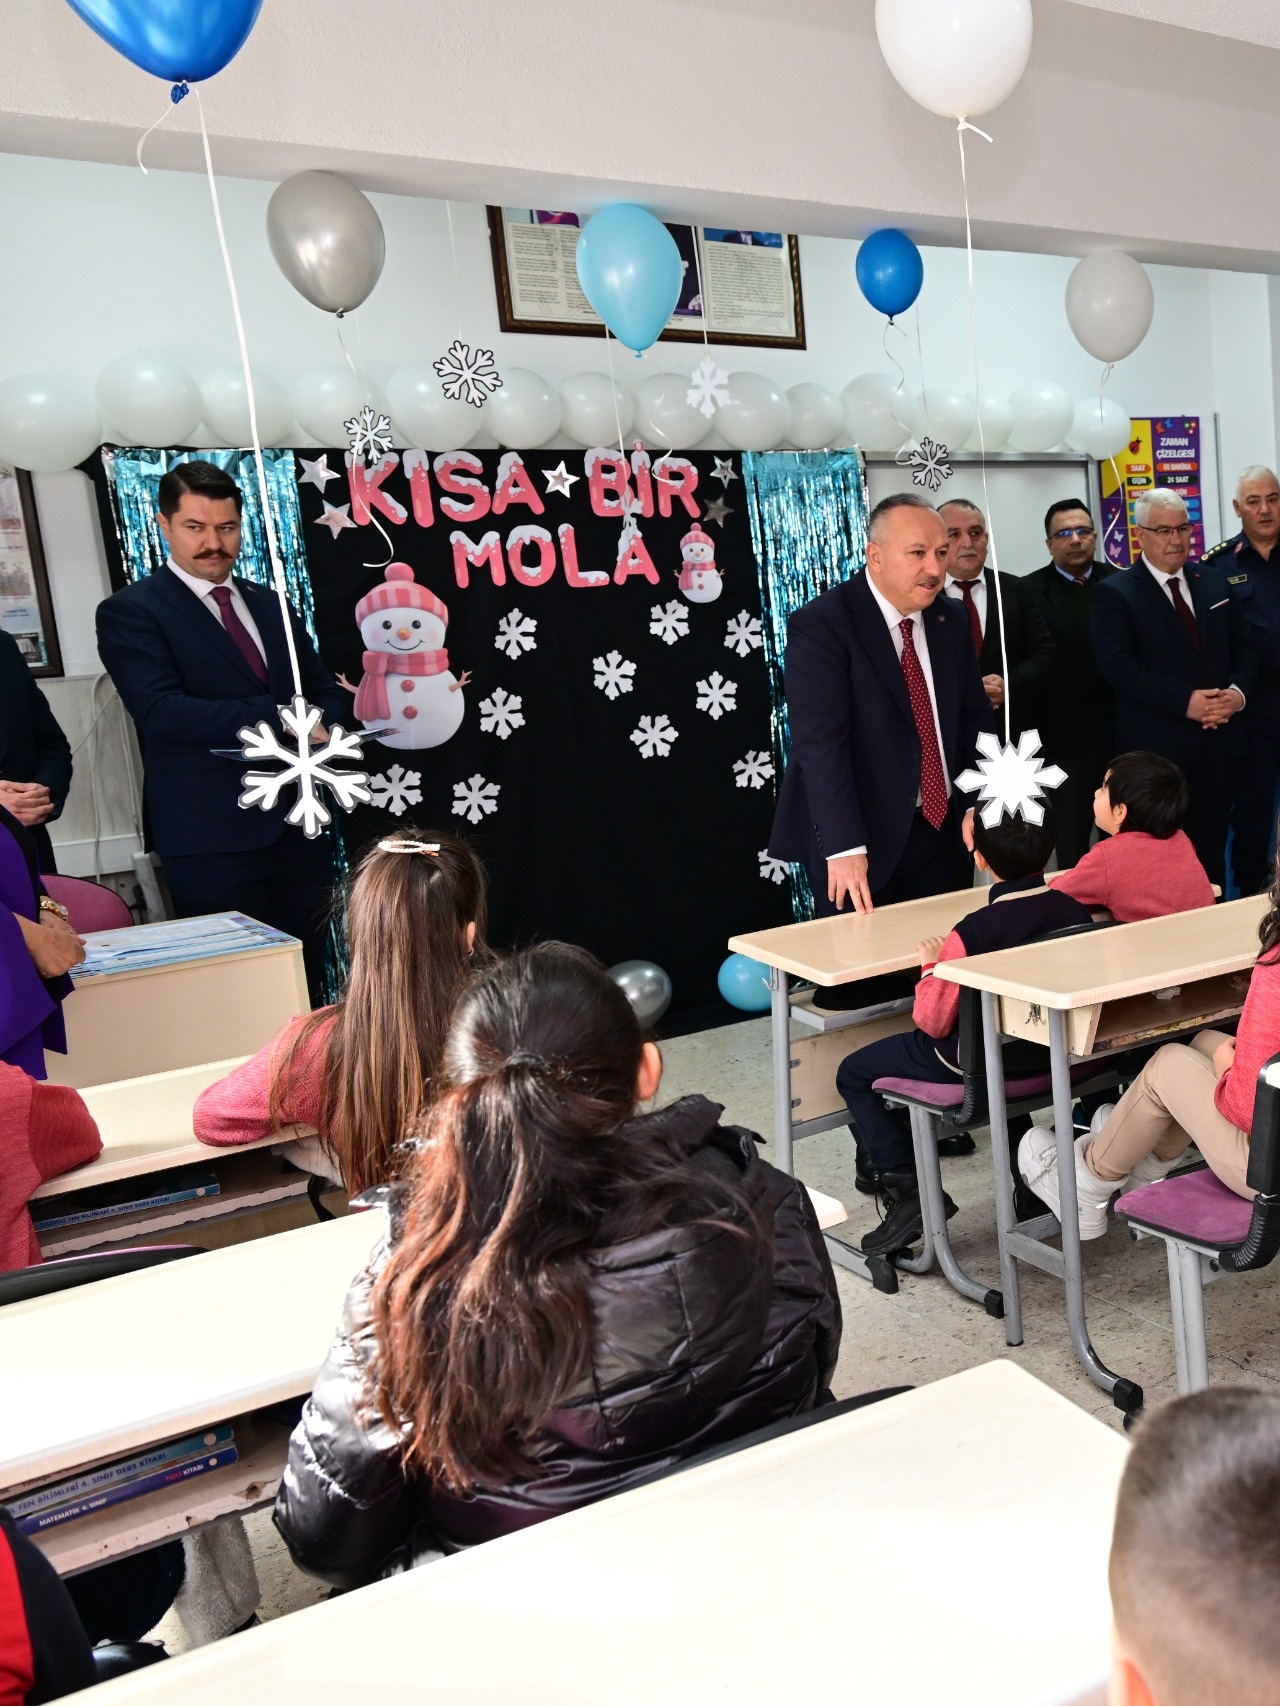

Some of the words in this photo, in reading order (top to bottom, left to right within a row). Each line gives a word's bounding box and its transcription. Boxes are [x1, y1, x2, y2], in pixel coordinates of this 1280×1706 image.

[1156, 448, 1195, 460] ÇİZELGESİ
[1160, 437, 1188, 446] ZAMAN
[344, 449, 545, 527] KISA
[584, 439, 701, 518] BİR
[450, 523, 660, 588] MOLA
[18, 1500, 35, 1511] FEN
[37, 1484, 79, 1503] BİLİMLERİ
[92, 1473, 114, 1484] SINIF
[116, 1464, 137, 1475] DERS
[139, 1453, 166, 1467] KİTABI
[39, 1507, 80, 1526] MATEMATİK
[90, 1498, 107, 1508] SINIF
[183, 1464, 204, 1475] KİTABI
